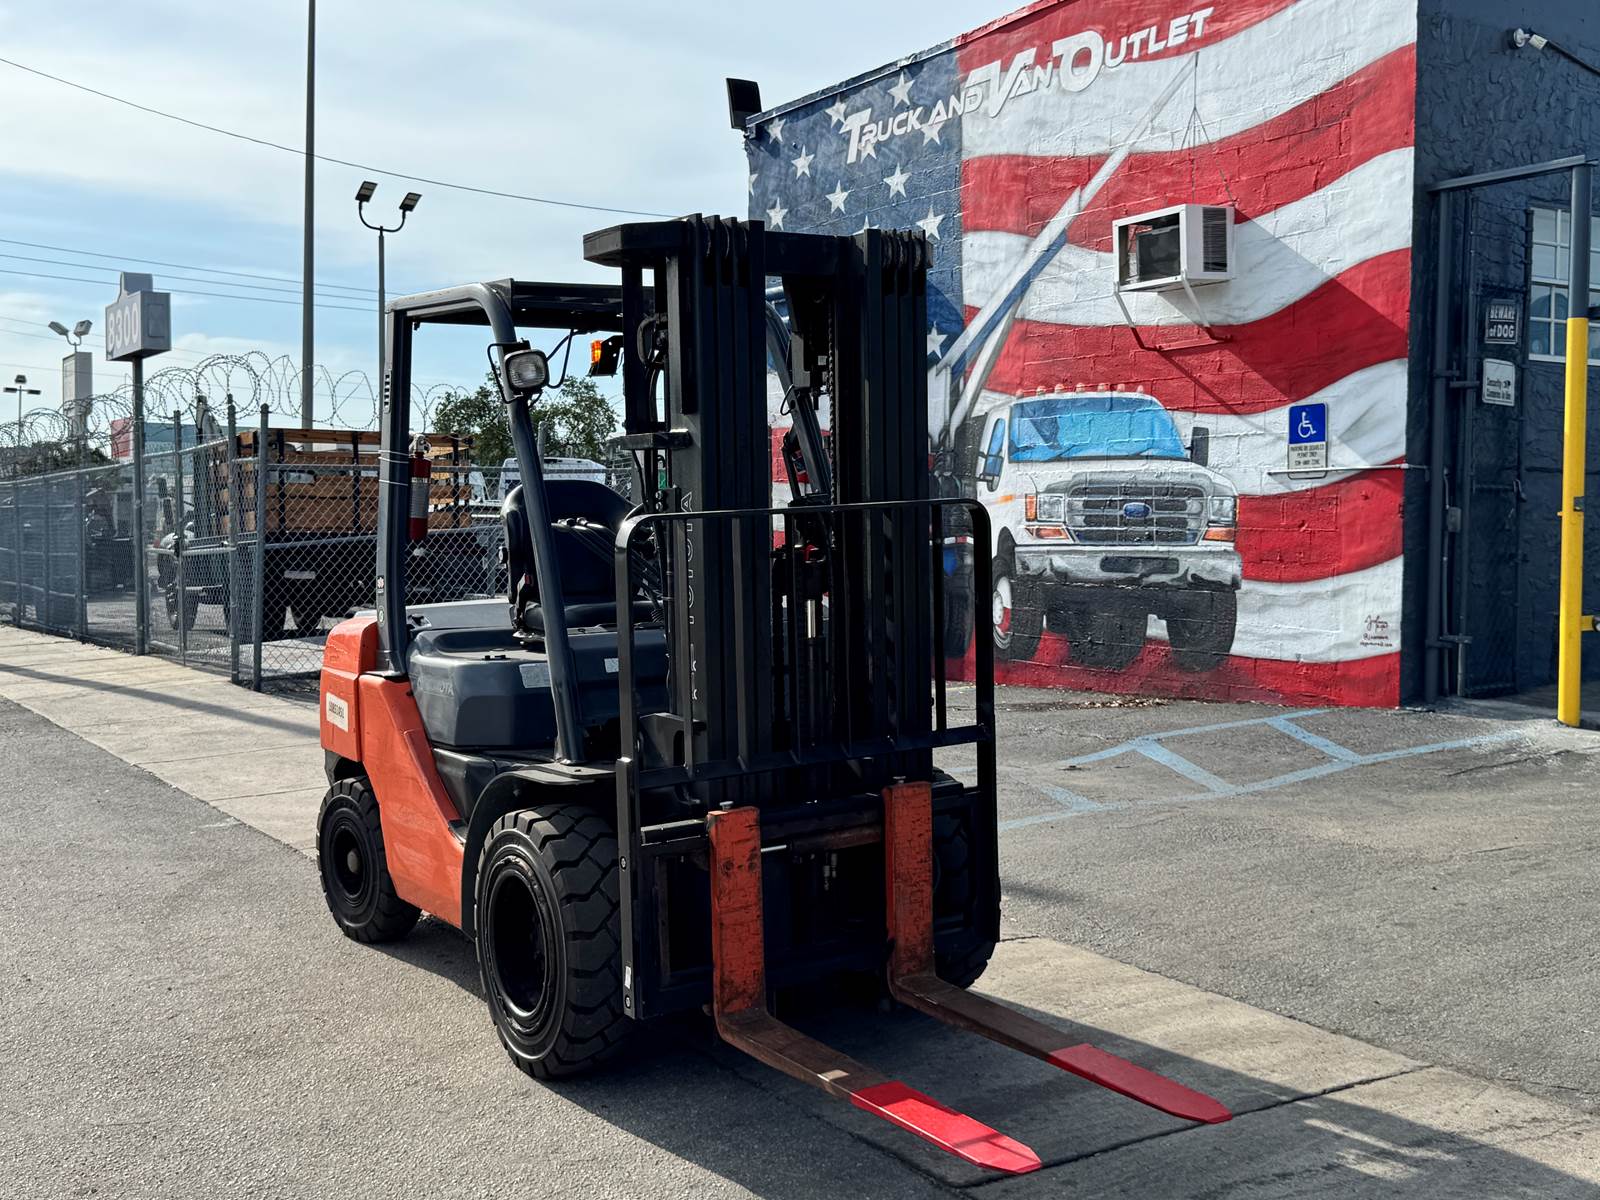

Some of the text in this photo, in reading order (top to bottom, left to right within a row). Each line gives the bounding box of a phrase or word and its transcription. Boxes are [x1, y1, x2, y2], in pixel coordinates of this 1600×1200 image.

[838, 6, 1216, 165] TRUCK AND VAN OUTLET
[107, 302, 139, 353] 8300
[1497, 324, 1515, 338] DOG
